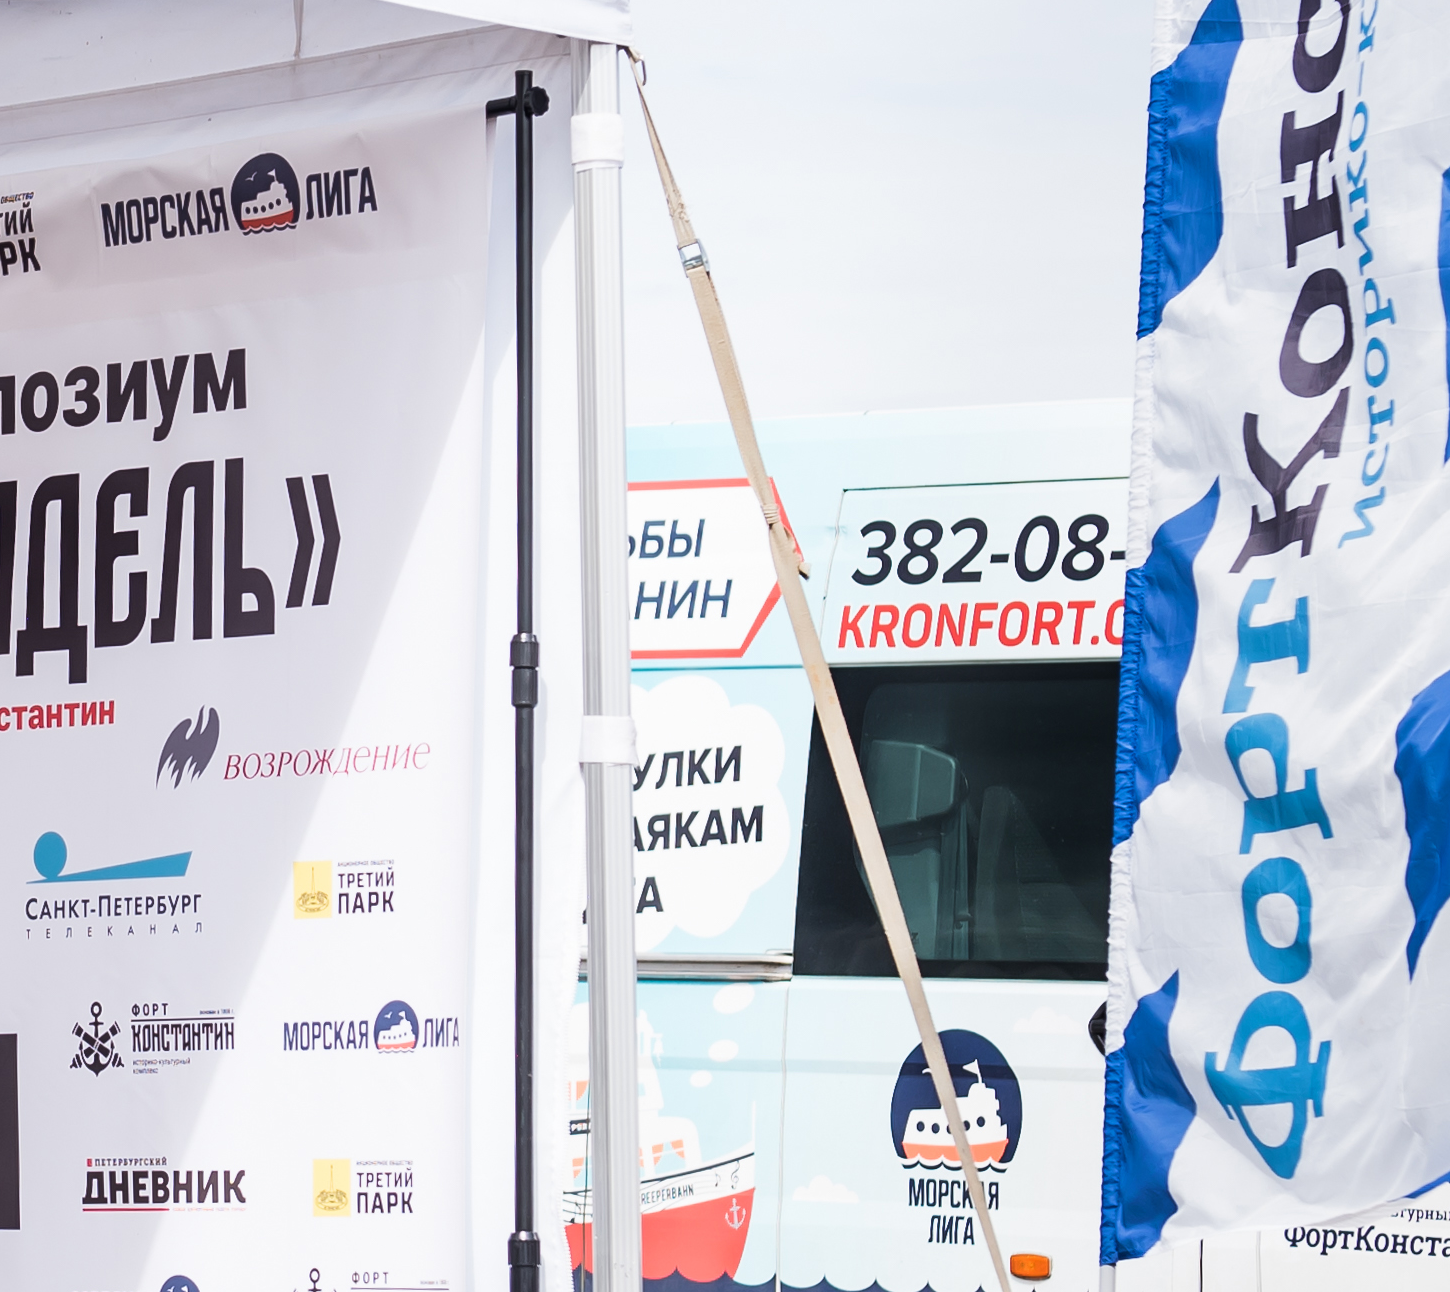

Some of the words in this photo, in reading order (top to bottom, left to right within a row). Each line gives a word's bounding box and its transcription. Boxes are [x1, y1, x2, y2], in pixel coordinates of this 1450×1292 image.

[101, 187, 230, 247] МОРСКАЯ
[306, 166, 377, 220] ЛИГА
[337, 866, 395, 889] ТРЕТИЙ
[338, 891, 394, 914] ПАРК
[131, 1003, 168, 1017] ФОРТ
[131, 1022, 234, 1052] КОНСТАНТИН
[284, 1020, 368, 1051] МОРСКАЯ
[422, 1017, 459, 1048] ЛИГА
[95, 1157, 167, 1166] ПЕТЕРБУРГСКИЙ
[82, 1170, 246, 1205] ДНЕВНИК
[357, 1168, 413, 1188] ТРЕТИЙ
[357, 1192, 413, 1214] ПАРК
[640, 1183, 695, 1205] REEPERBAHN
[907, 1177, 1000, 1211] МОРСКЯ
[928, 1215, 975, 1245] ЛИГА
[352, 1271, 389, 1284] ФОРТ
